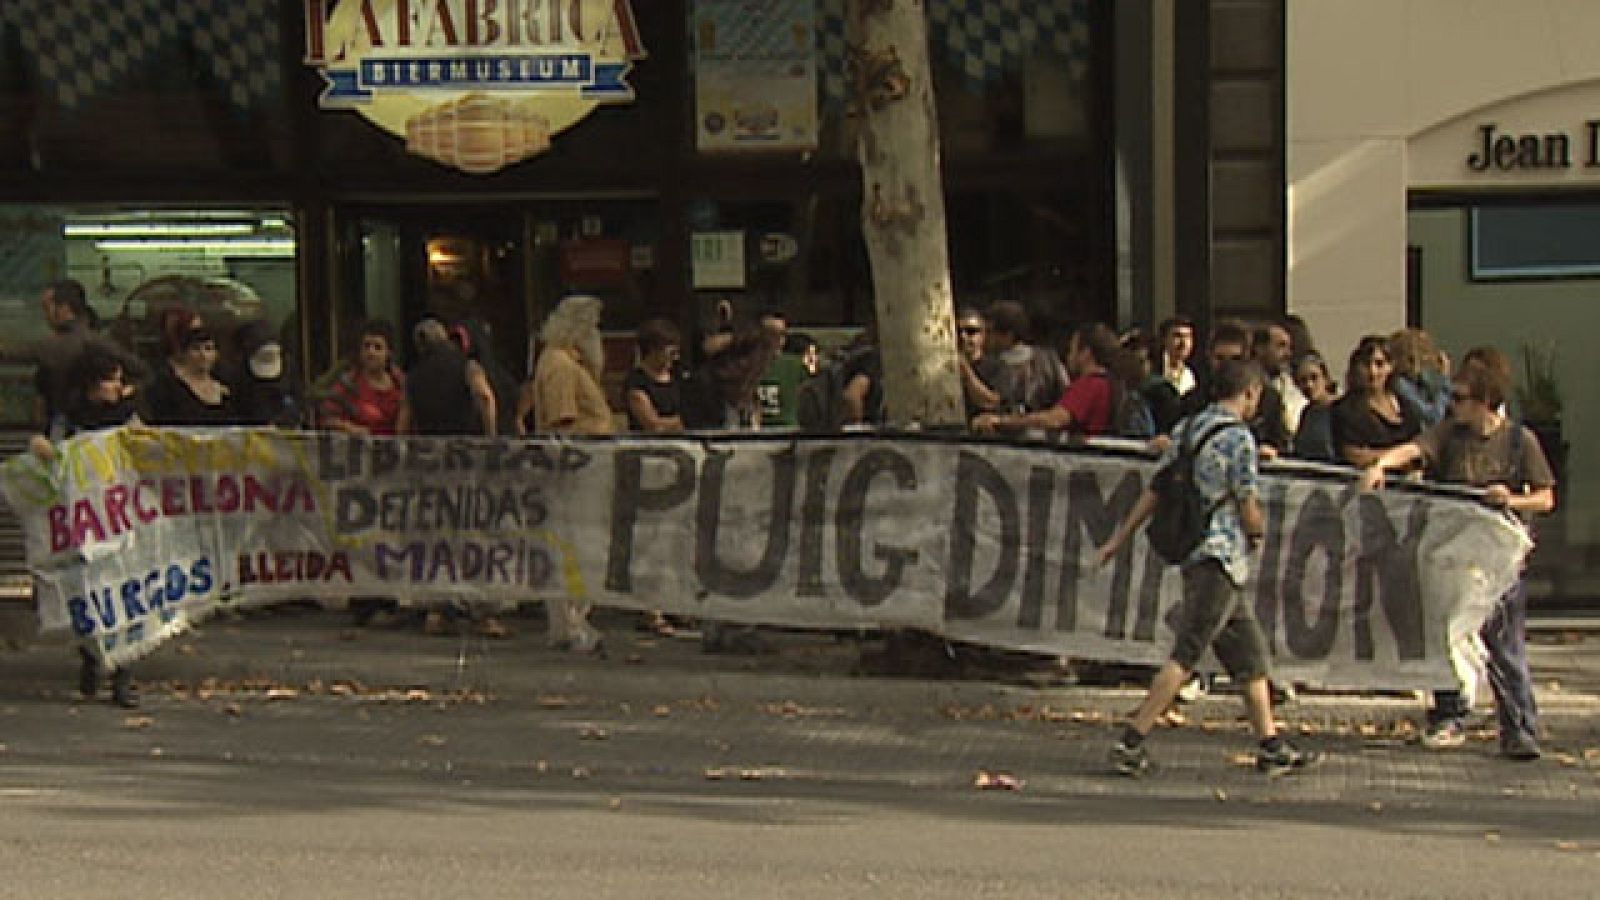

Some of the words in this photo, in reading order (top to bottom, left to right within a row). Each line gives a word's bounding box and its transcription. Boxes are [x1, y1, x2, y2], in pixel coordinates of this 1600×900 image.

[371, 58, 582, 83] BIERMUSEUM
[1467, 124, 1571, 171] Jean
[318, 434, 592, 480] LIBERTAD
[49, 474, 317, 552] BARCELONA
[336, 484, 549, 534] DETENIDAS
[605, 442, 919, 606] PUIG
[238, 551, 353, 584] LLEIDA
[374, 537, 554, 591] MADRID
